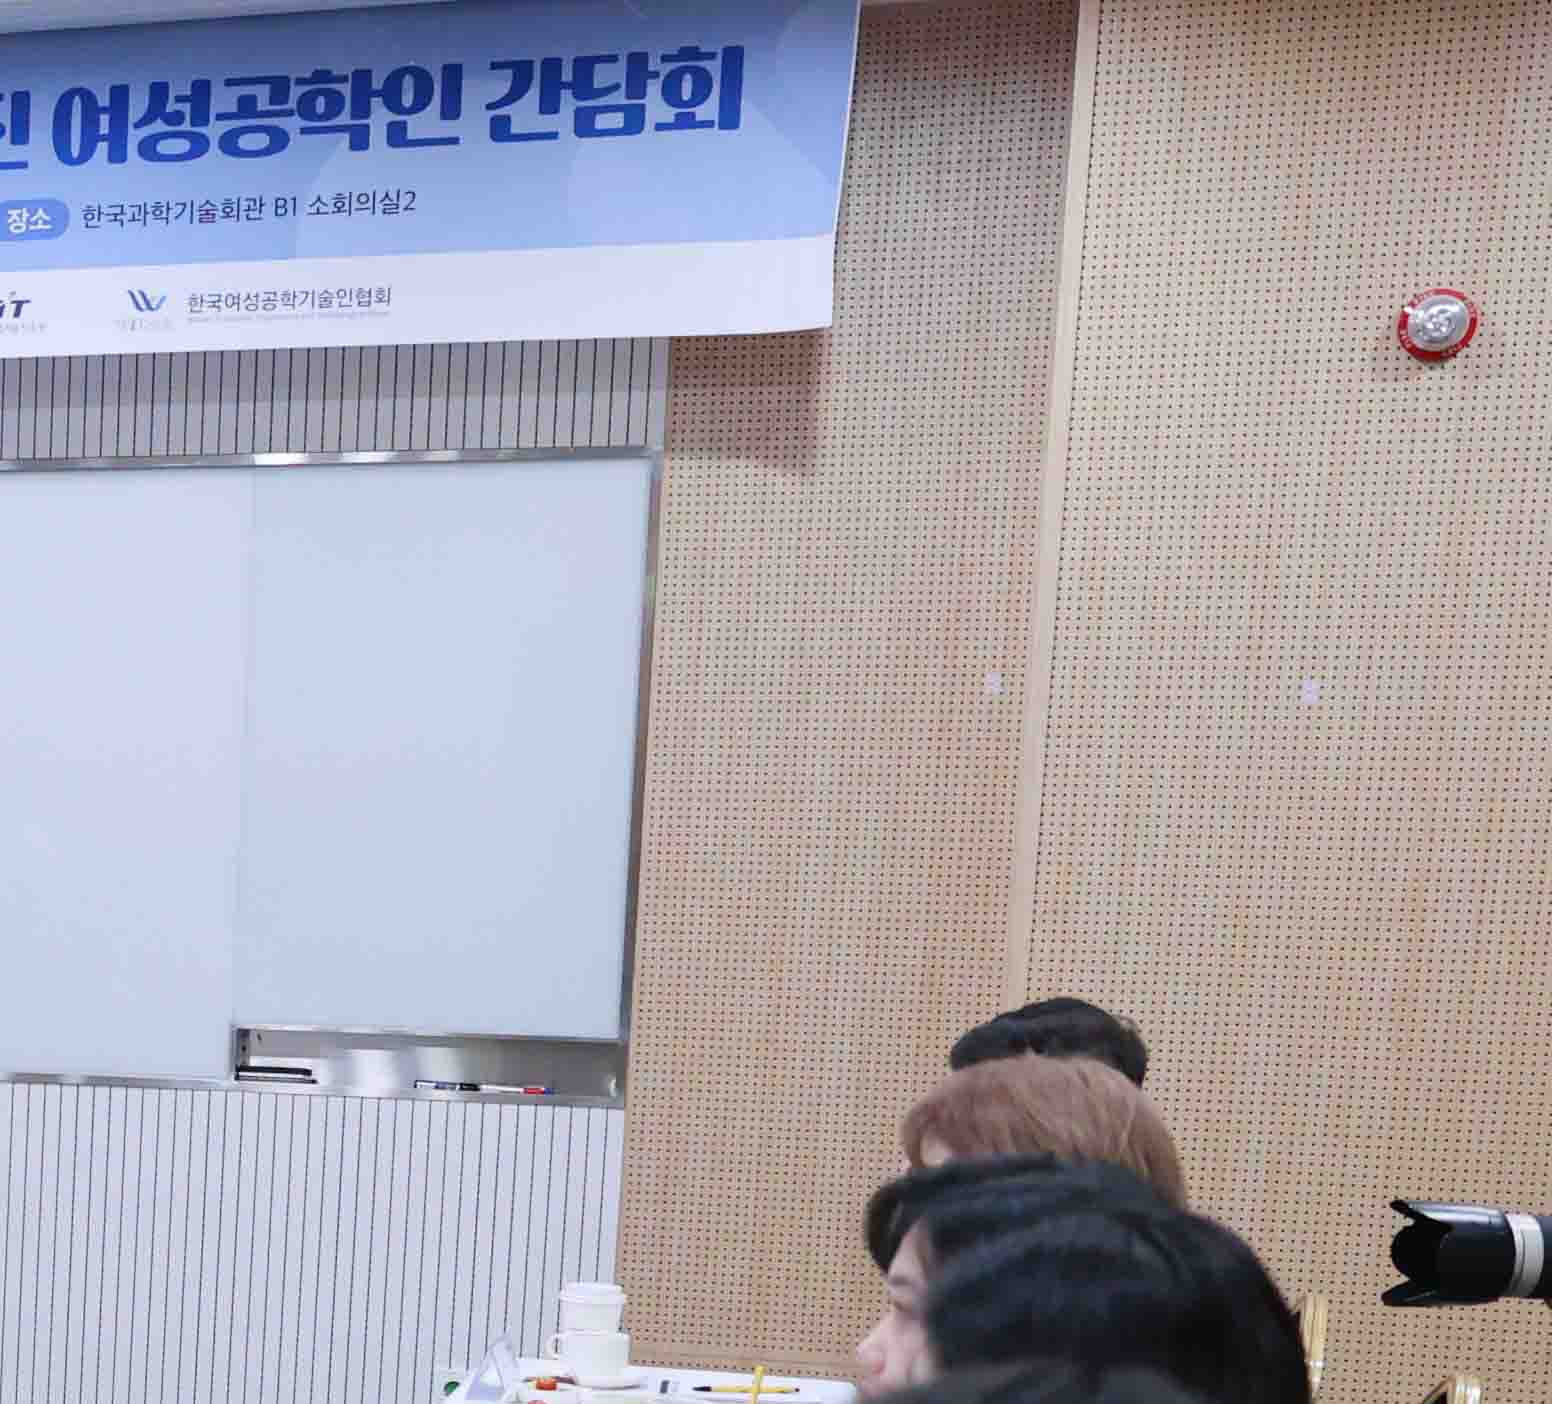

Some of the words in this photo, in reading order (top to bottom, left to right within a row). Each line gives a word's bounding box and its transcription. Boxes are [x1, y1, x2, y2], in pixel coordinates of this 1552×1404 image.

[51, 62, 465, 168] 여성공학인
[484, 45, 746, 144] 간담회
[6, 206, 53, 234] 장소
[81, 195, 266, 229] 한국과학기술회관
[273, 196, 298, 218] B1
[307, 188, 418, 217] 소회의실2
[188, 287, 392, 313] 한국여성공학기술인협회
